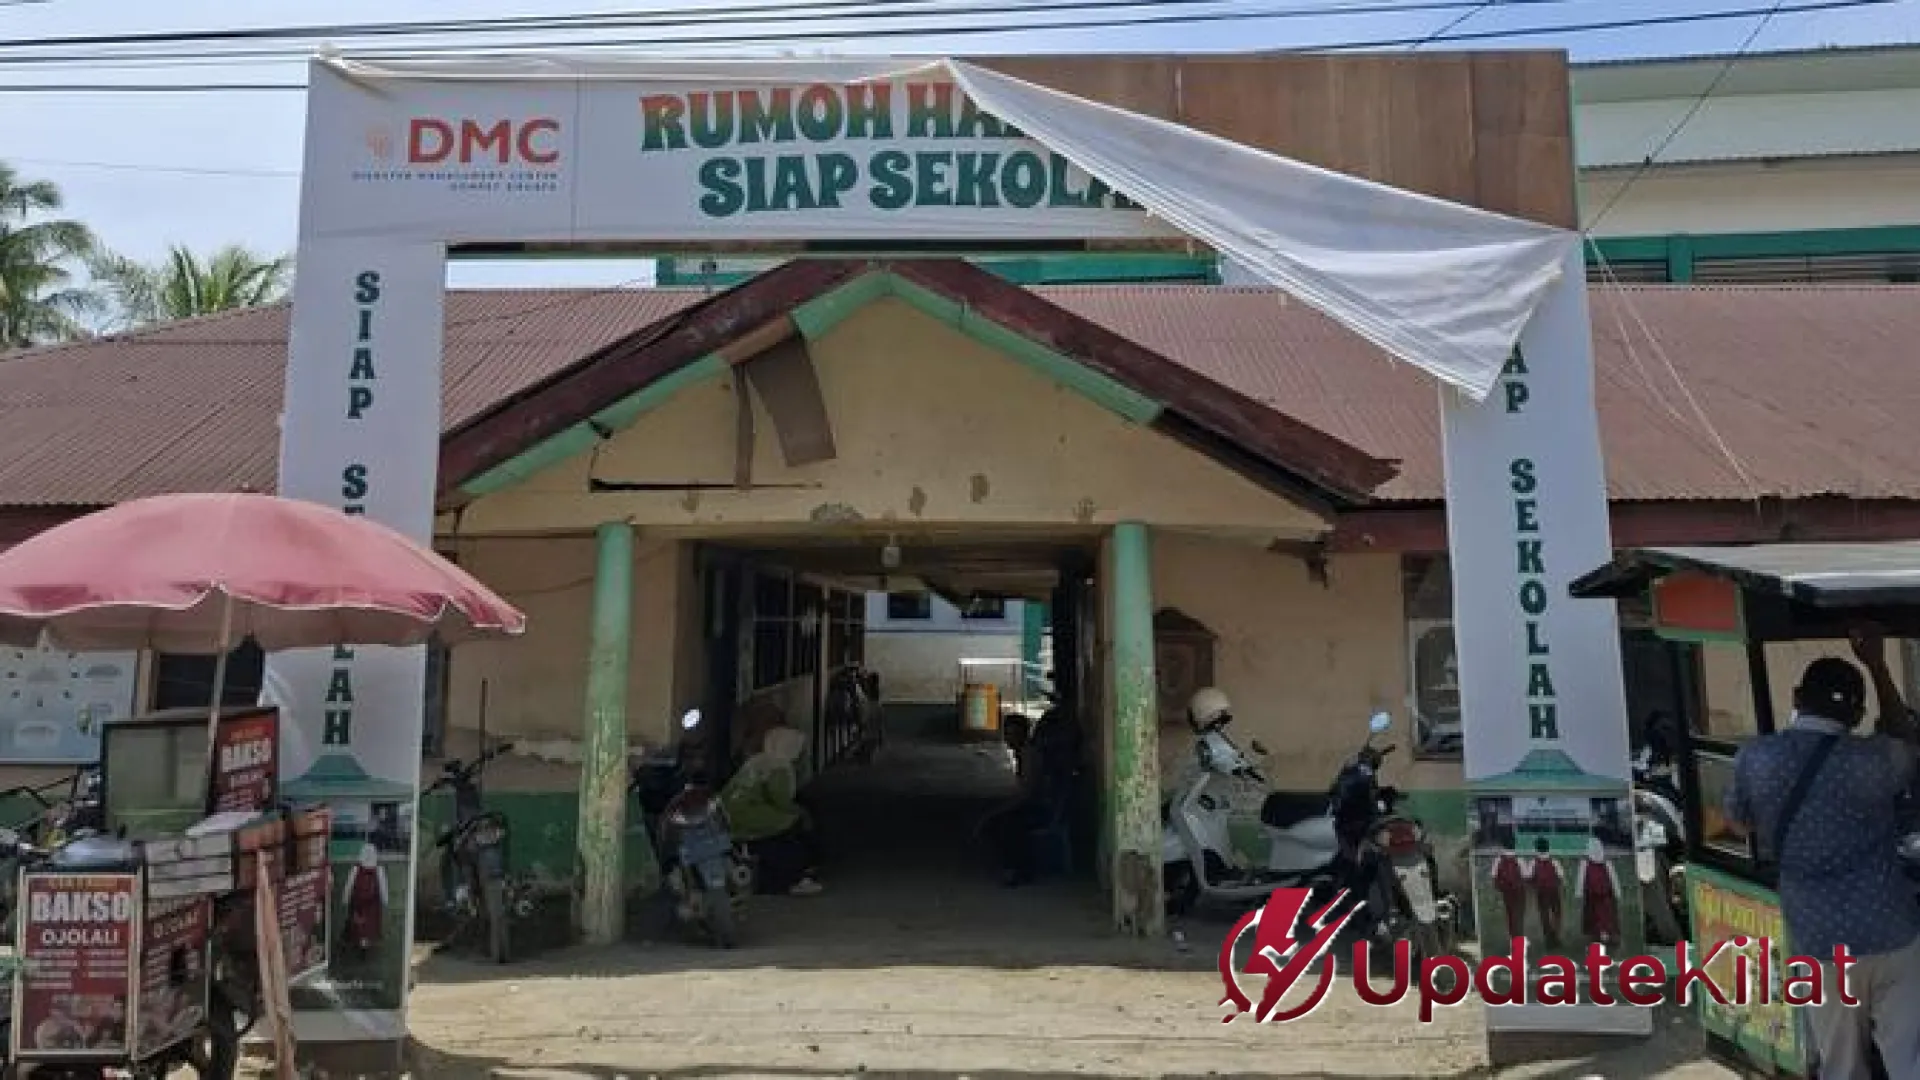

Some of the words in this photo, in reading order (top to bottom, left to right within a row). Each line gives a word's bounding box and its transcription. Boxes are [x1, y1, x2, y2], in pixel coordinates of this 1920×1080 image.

[407, 118, 560, 163] DMC
[640, 82, 893, 151] RUMOH
[907, 82, 1024, 138] HA
[700, 152, 859, 217] SIAP
[868, 150, 1148, 212] SEKOL
[347, 270, 380, 420] SIAP
[1509, 458, 1559, 740] SEKOLAH
[31, 891, 130, 922] BAKSO
[42, 928, 119, 945] OJOLALI
